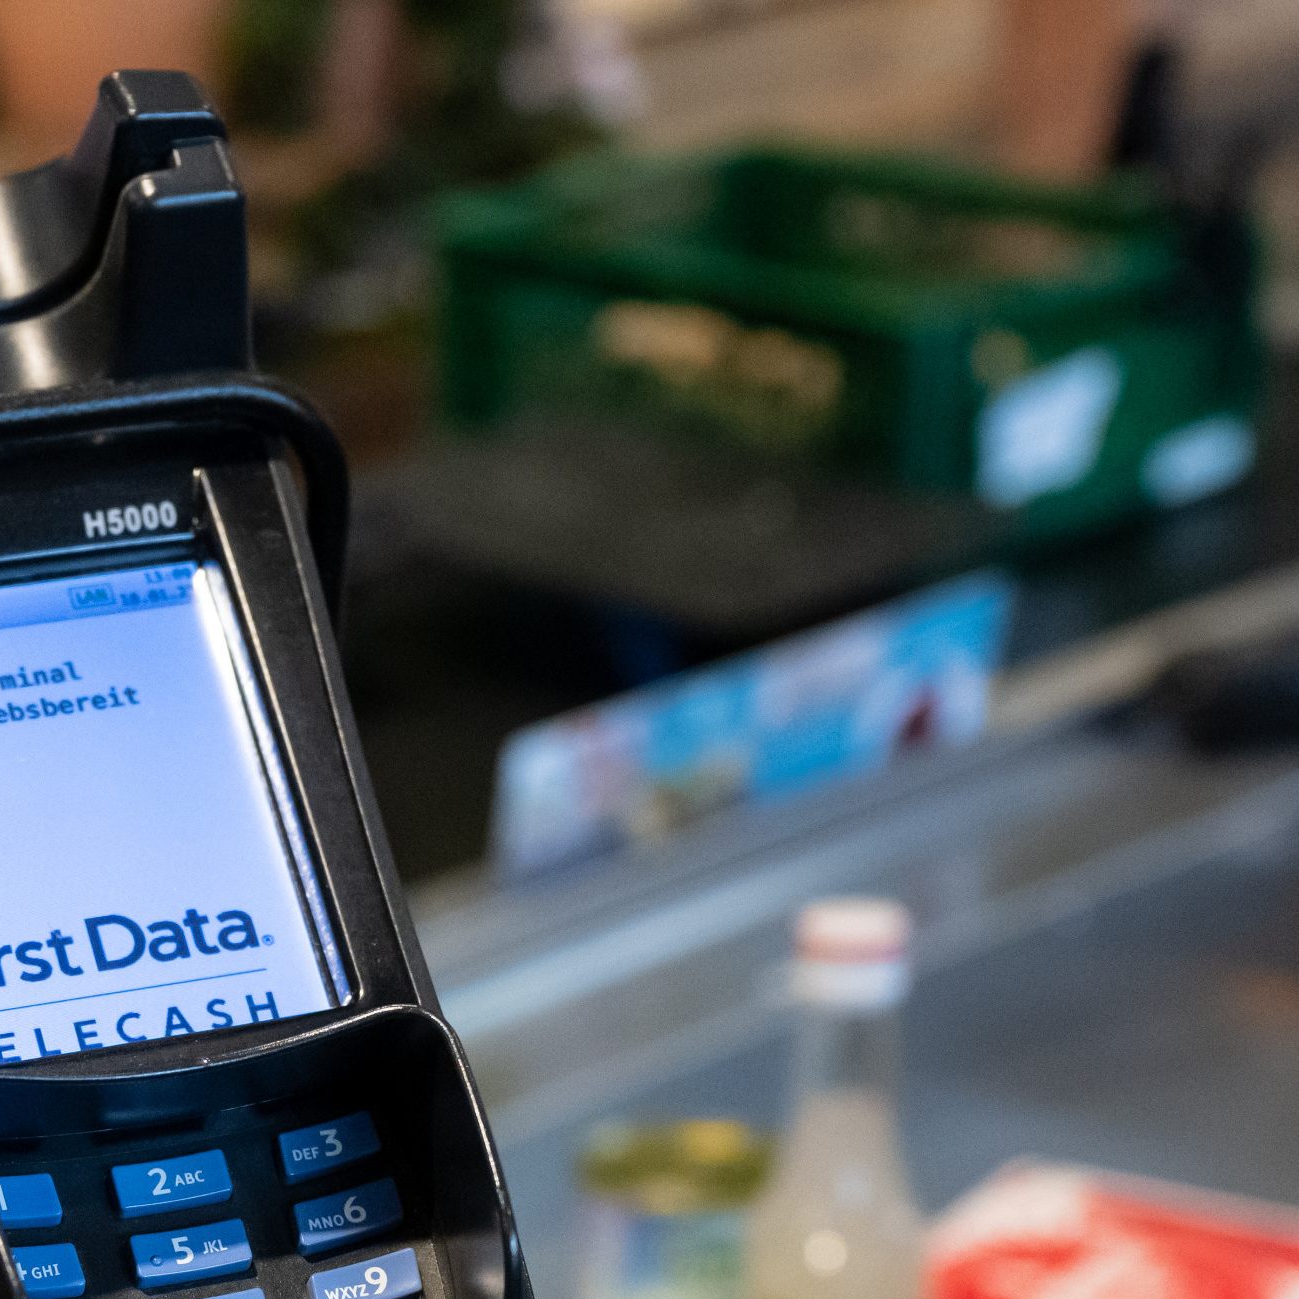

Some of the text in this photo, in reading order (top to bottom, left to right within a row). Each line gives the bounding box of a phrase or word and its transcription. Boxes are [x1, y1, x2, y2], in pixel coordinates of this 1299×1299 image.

[83, 500, 178, 539] H5000
[291, 1128, 344, 1162] DEF 3
[147, 1167, 205, 1196] 2 ABC
[307, 1195, 367, 1231] MNO 6
[171, 1236, 229, 1265] 5 JKL
[31, 1262, 61, 1280] GHI
[364, 1266, 388, 1295] 9
